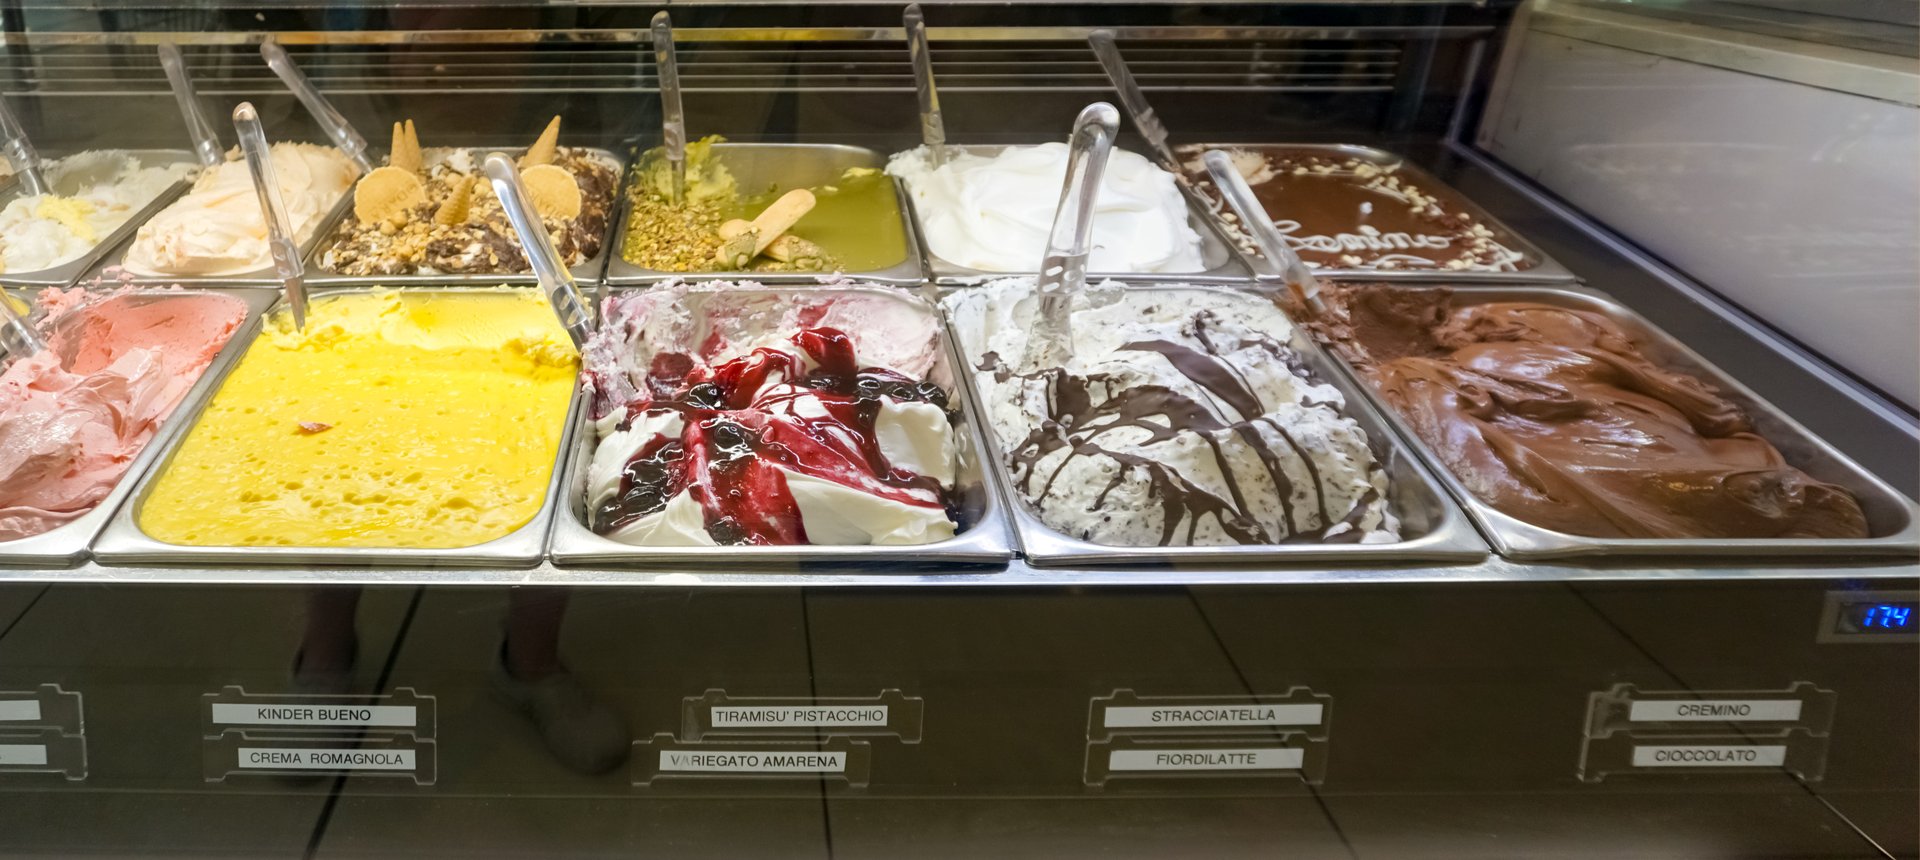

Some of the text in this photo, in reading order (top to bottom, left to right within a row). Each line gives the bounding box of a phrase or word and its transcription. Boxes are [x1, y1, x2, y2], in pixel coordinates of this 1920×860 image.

[257, 708, 372, 722] KINDER BUENO
[715, 710, 884, 723] TIRAMISU' PISTACCHIO
[1151, 709, 1276, 722] STRACCIATELLA
[1677, 703, 1752, 717] CREMINO
[250, 752, 404, 765] CREMA ROMAGNOLA
[670, 754, 838, 768] VARIEGATO AMARENA
[1156, 753, 1257, 765] FIORDILATTE
[1654, 749, 1758, 762] CIOCCOLATO
